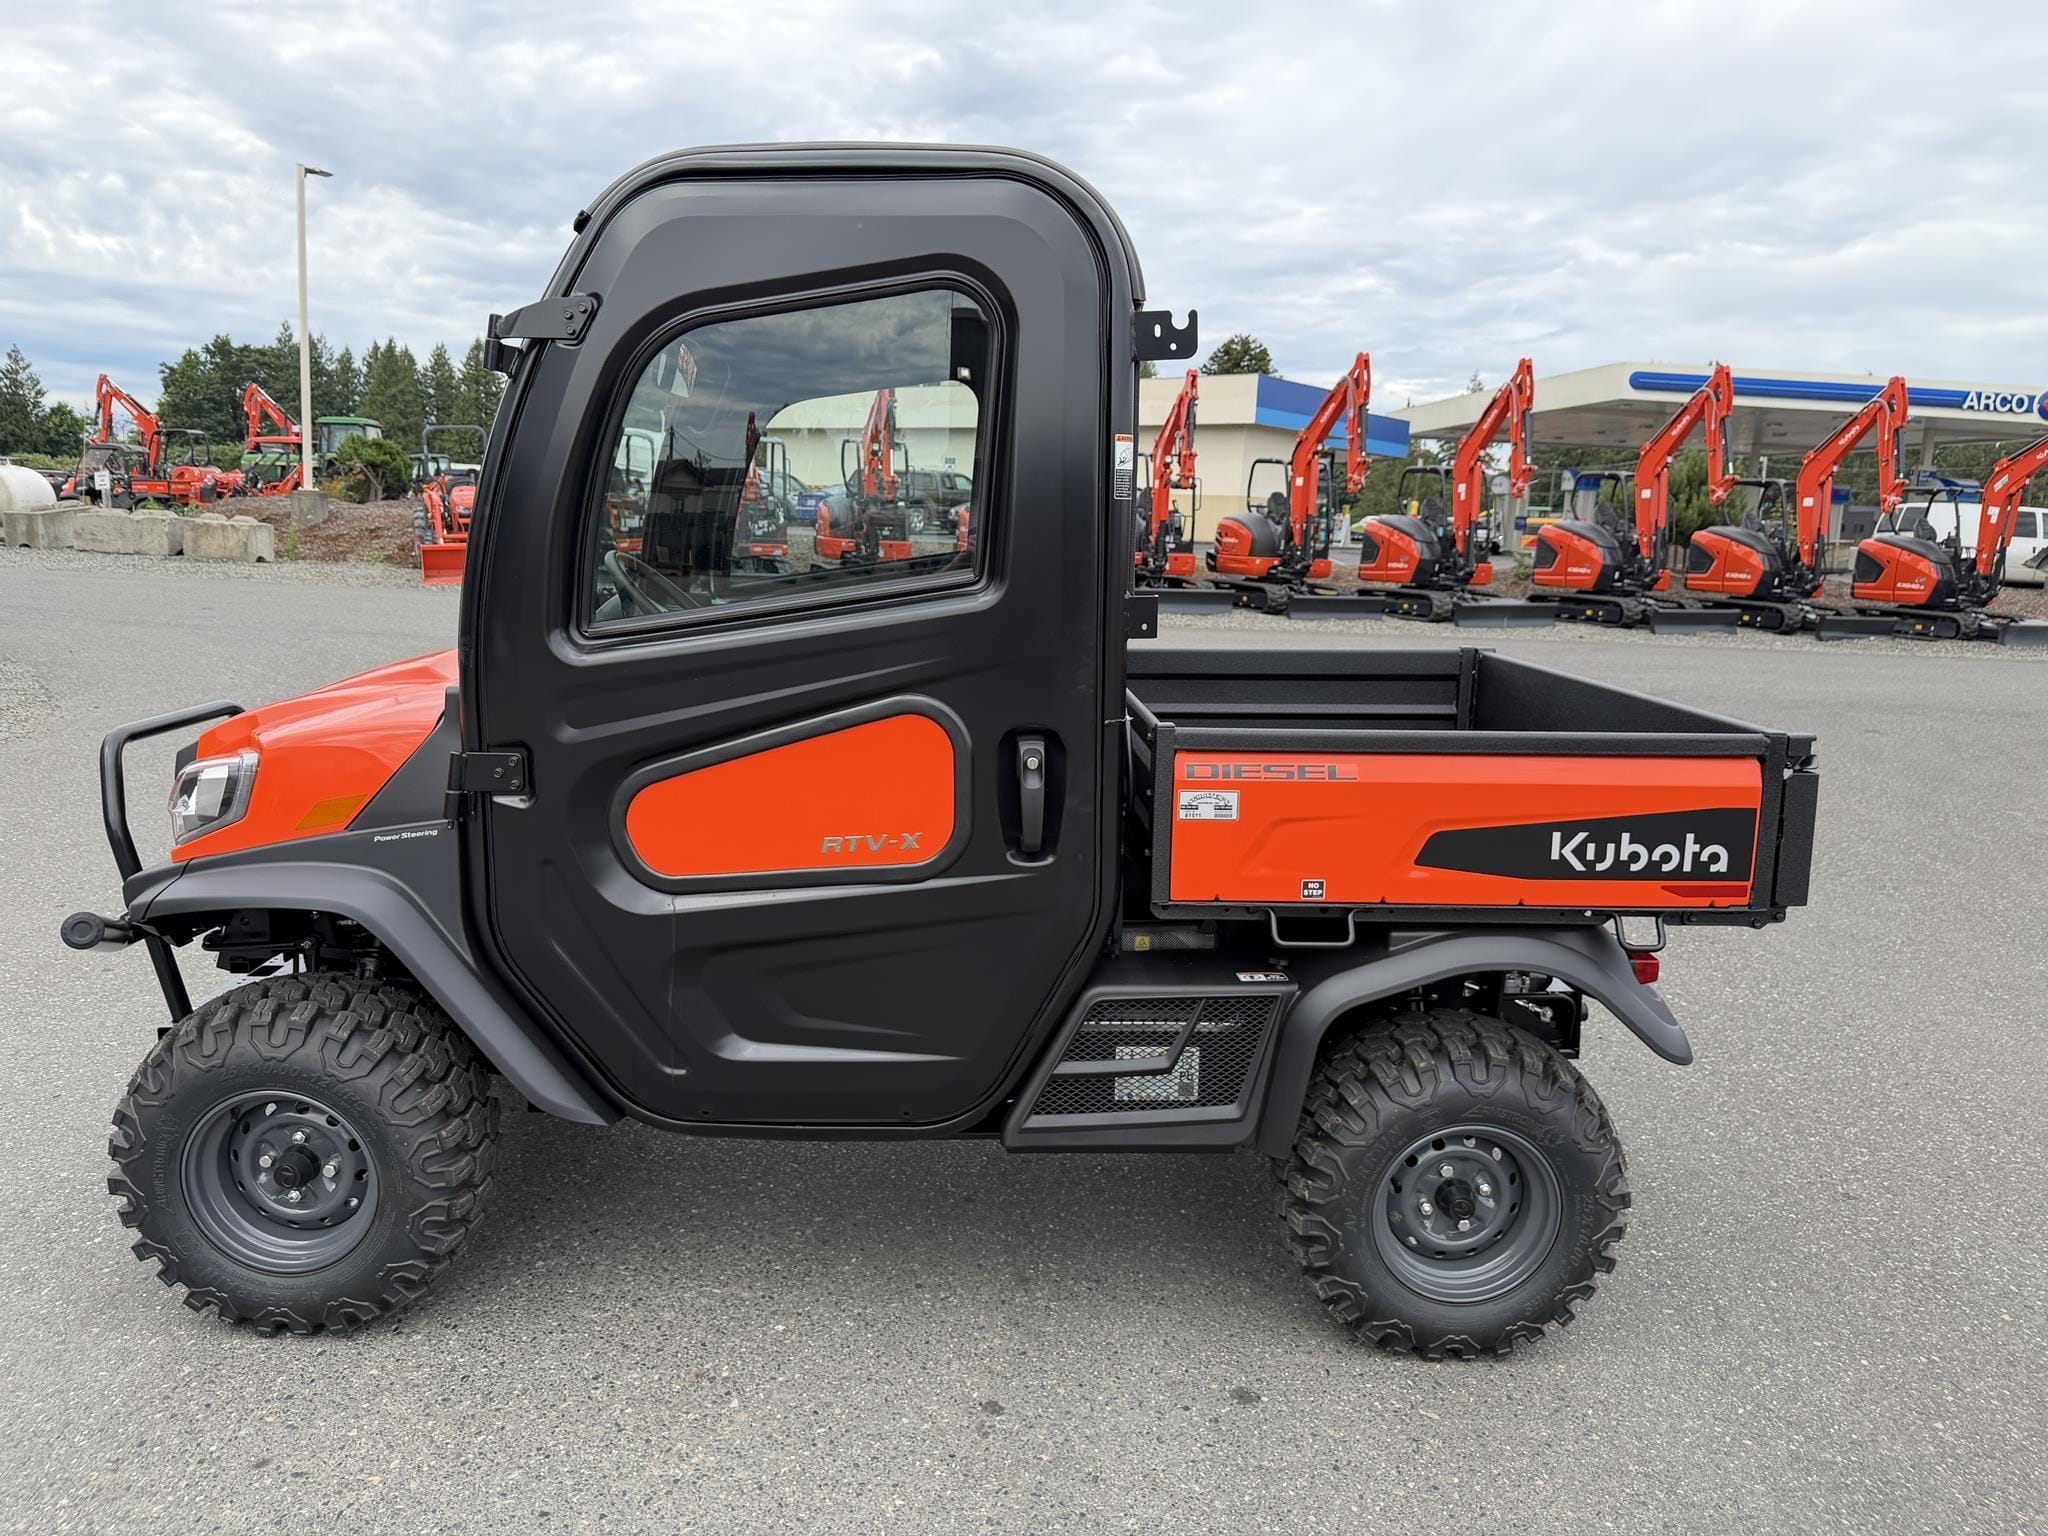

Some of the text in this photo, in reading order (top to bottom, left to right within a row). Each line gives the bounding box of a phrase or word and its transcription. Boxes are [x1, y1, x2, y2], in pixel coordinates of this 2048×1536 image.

[1962, 391, 2029, 414] ARCO
[1186, 763, 1358, 781] DIESEL
[821, 832, 922, 854] RTV-X
[1550, 831, 1729, 873] Kubota
